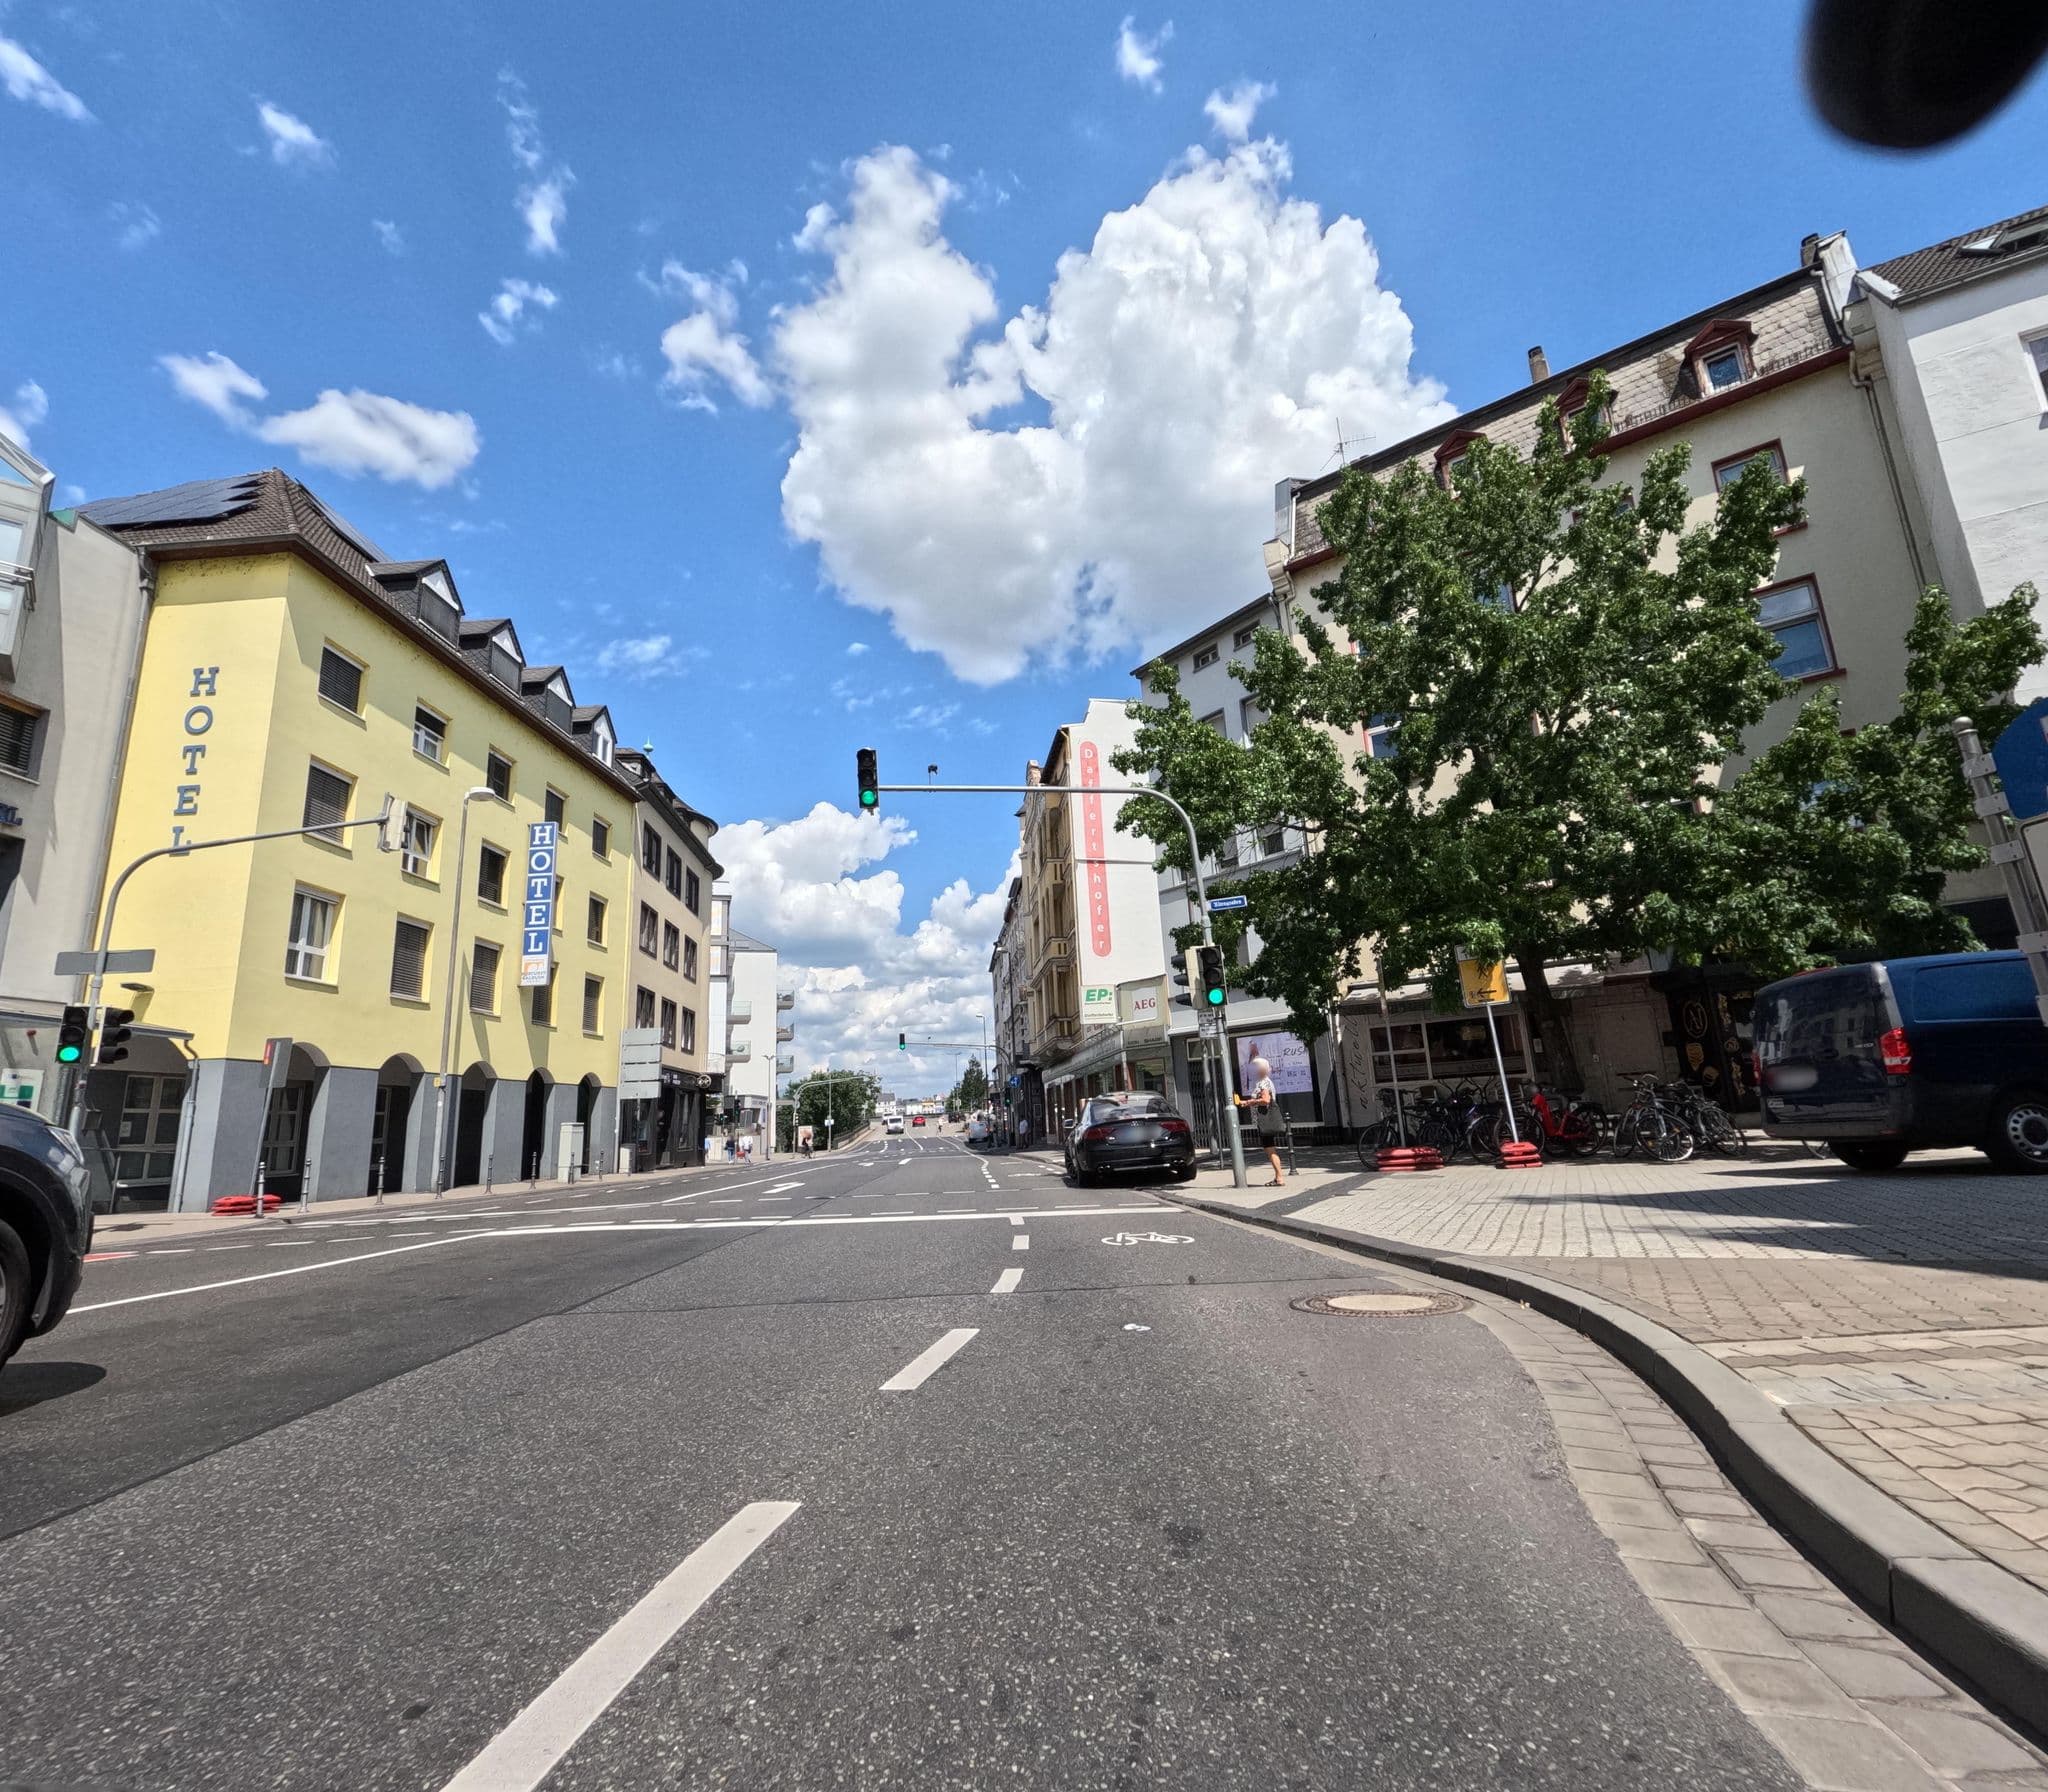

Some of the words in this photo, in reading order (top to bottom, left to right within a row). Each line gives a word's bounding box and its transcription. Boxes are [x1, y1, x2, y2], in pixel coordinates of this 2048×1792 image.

[168, 666, 220, 856] HOTEL
[1084, 748, 1105, 949] Daffertshofer
[527, 825, 552, 953] HOTEL
[1085, 988, 1113, 1002] EP:
[1133, 997, 1156, 1011] AEG
[1283, 1046, 1309, 1057] RUS
